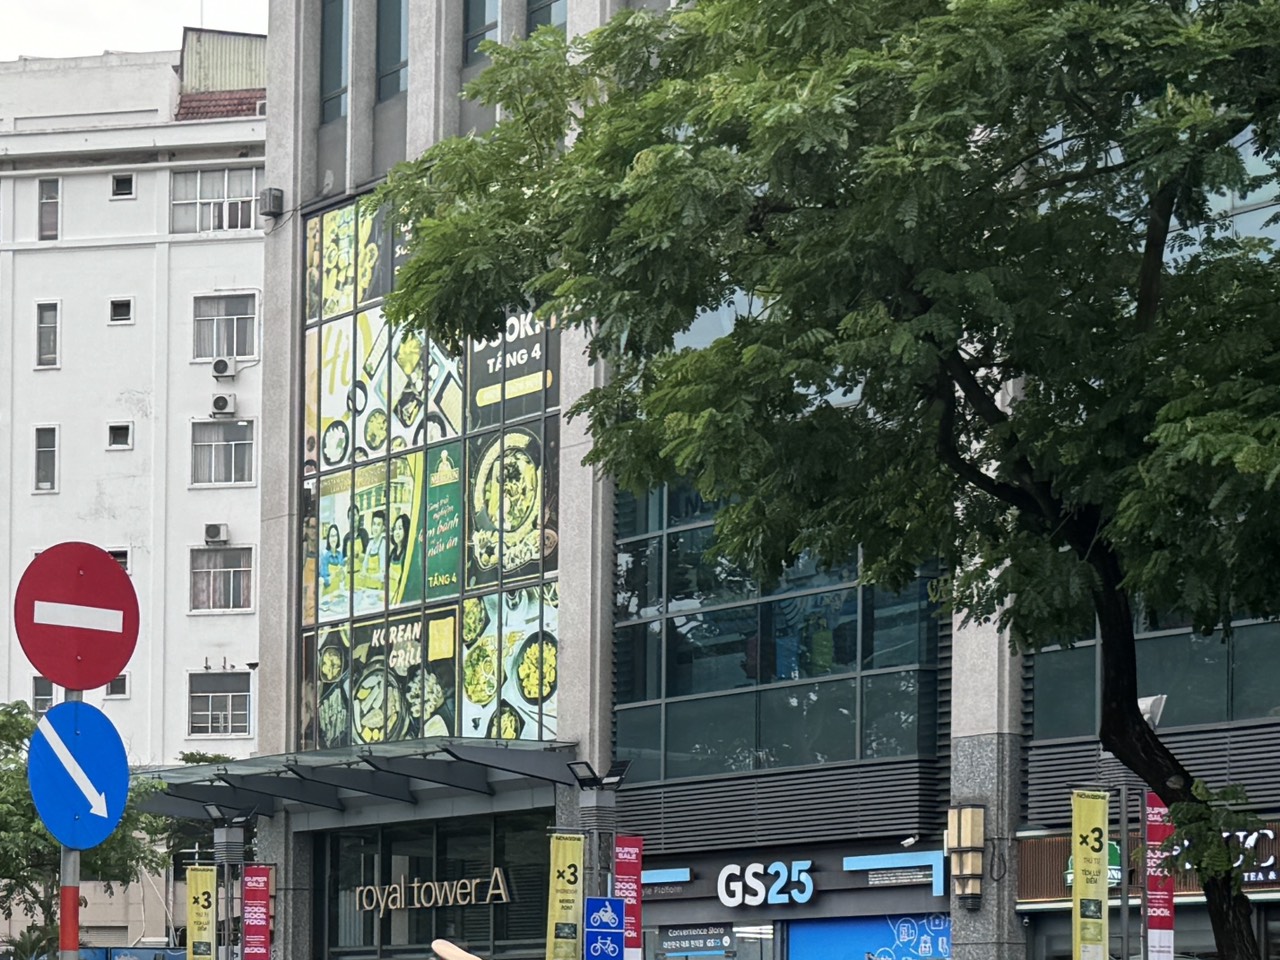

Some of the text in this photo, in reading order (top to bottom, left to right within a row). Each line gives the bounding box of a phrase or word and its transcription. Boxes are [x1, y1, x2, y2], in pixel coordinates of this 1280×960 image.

[531, 343, 541, 360] 4
[717, 860, 814, 908] GS25
[1243, 870, 1277, 881] TEA &
[355, 866, 511, 919] royal tower A
[668, 926, 724, 937] Convenience Store
